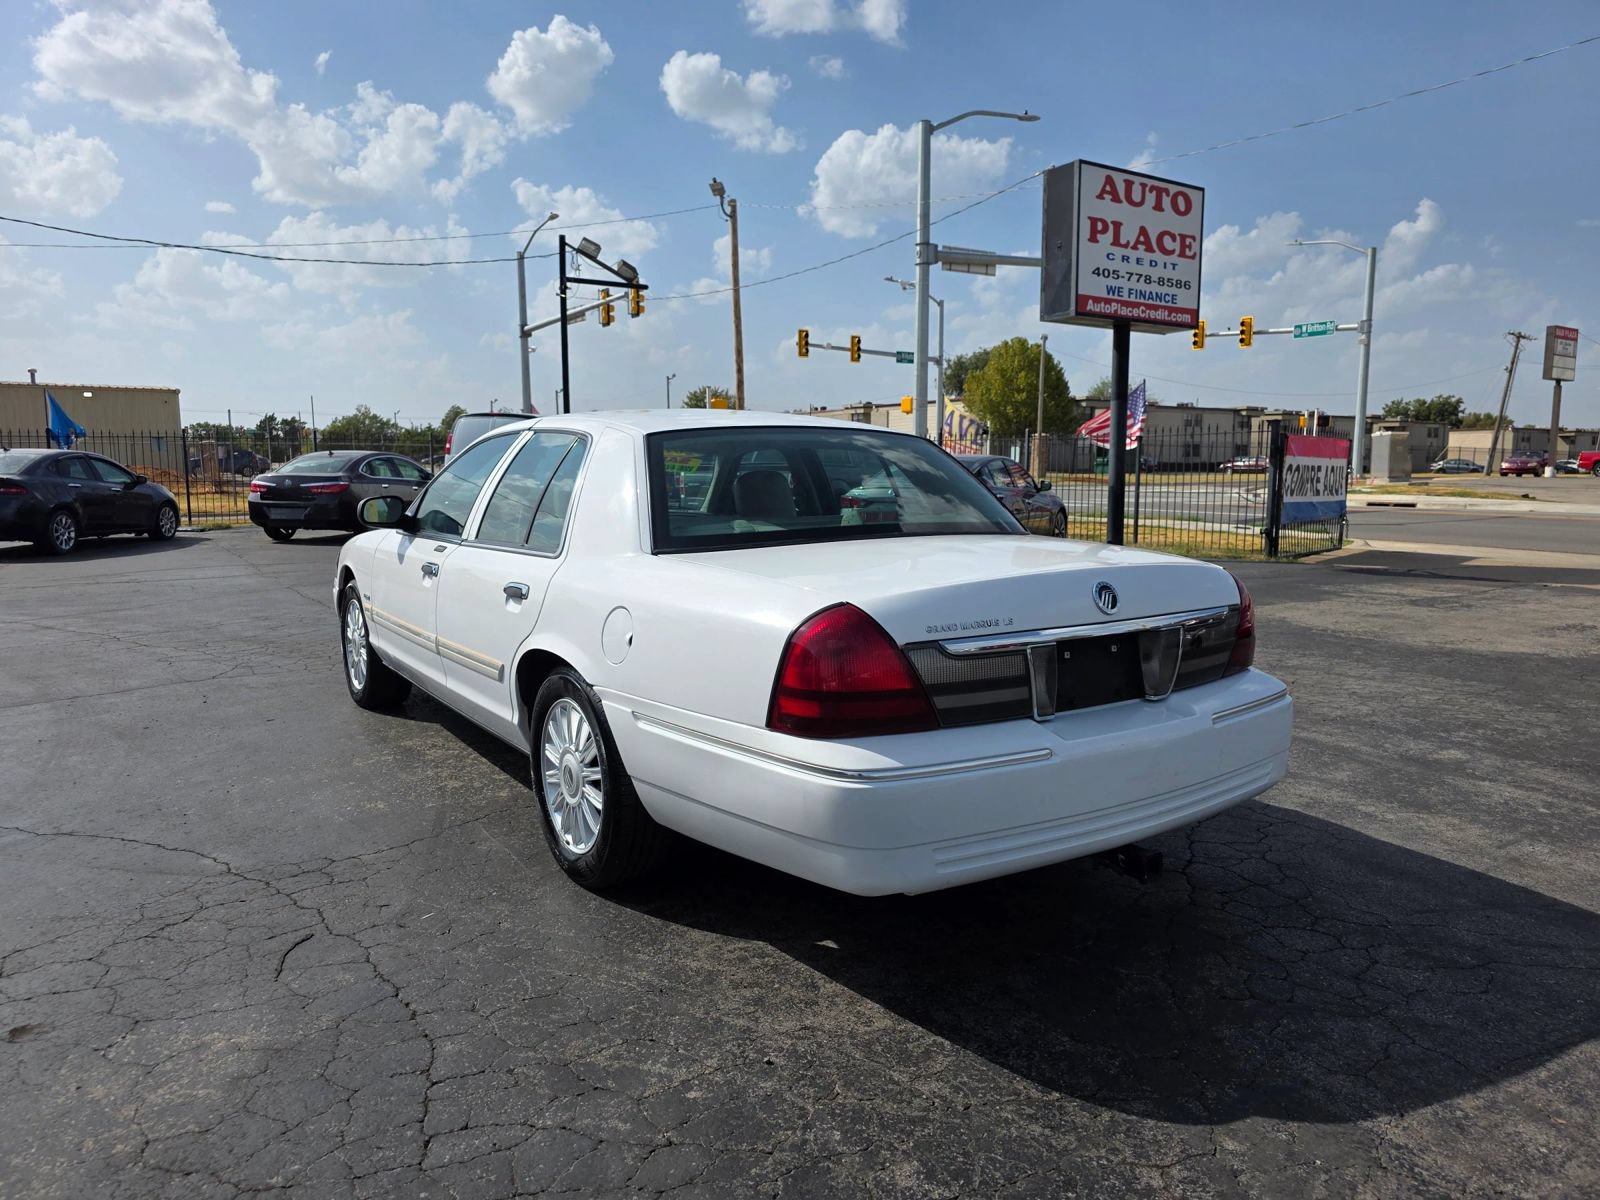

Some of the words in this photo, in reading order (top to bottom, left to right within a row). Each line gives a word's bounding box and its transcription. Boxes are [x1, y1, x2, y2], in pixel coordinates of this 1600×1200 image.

[1096, 174, 1193, 217] AUTO
[1087, 216, 1197, 261] PLACE
[1106, 252, 1179, 271] CREDIT
[1091, 266, 1192, 291] 405-778-8586
[1106, 285, 1124, 299] WE
[1128, 288, 1178, 305] FINANCE
[1086, 299, 1191, 323] AutoPlaceCredit.com
[1308, 323, 1327, 333] Britton
[1327, 321, 1334, 330] Rd
[1284, 463, 1322, 497] COMPRE
[925, 622, 958, 634] GRAND
[960, 617, 1000, 631] MARQUIS
[1002, 617, 1014, 627] LS
